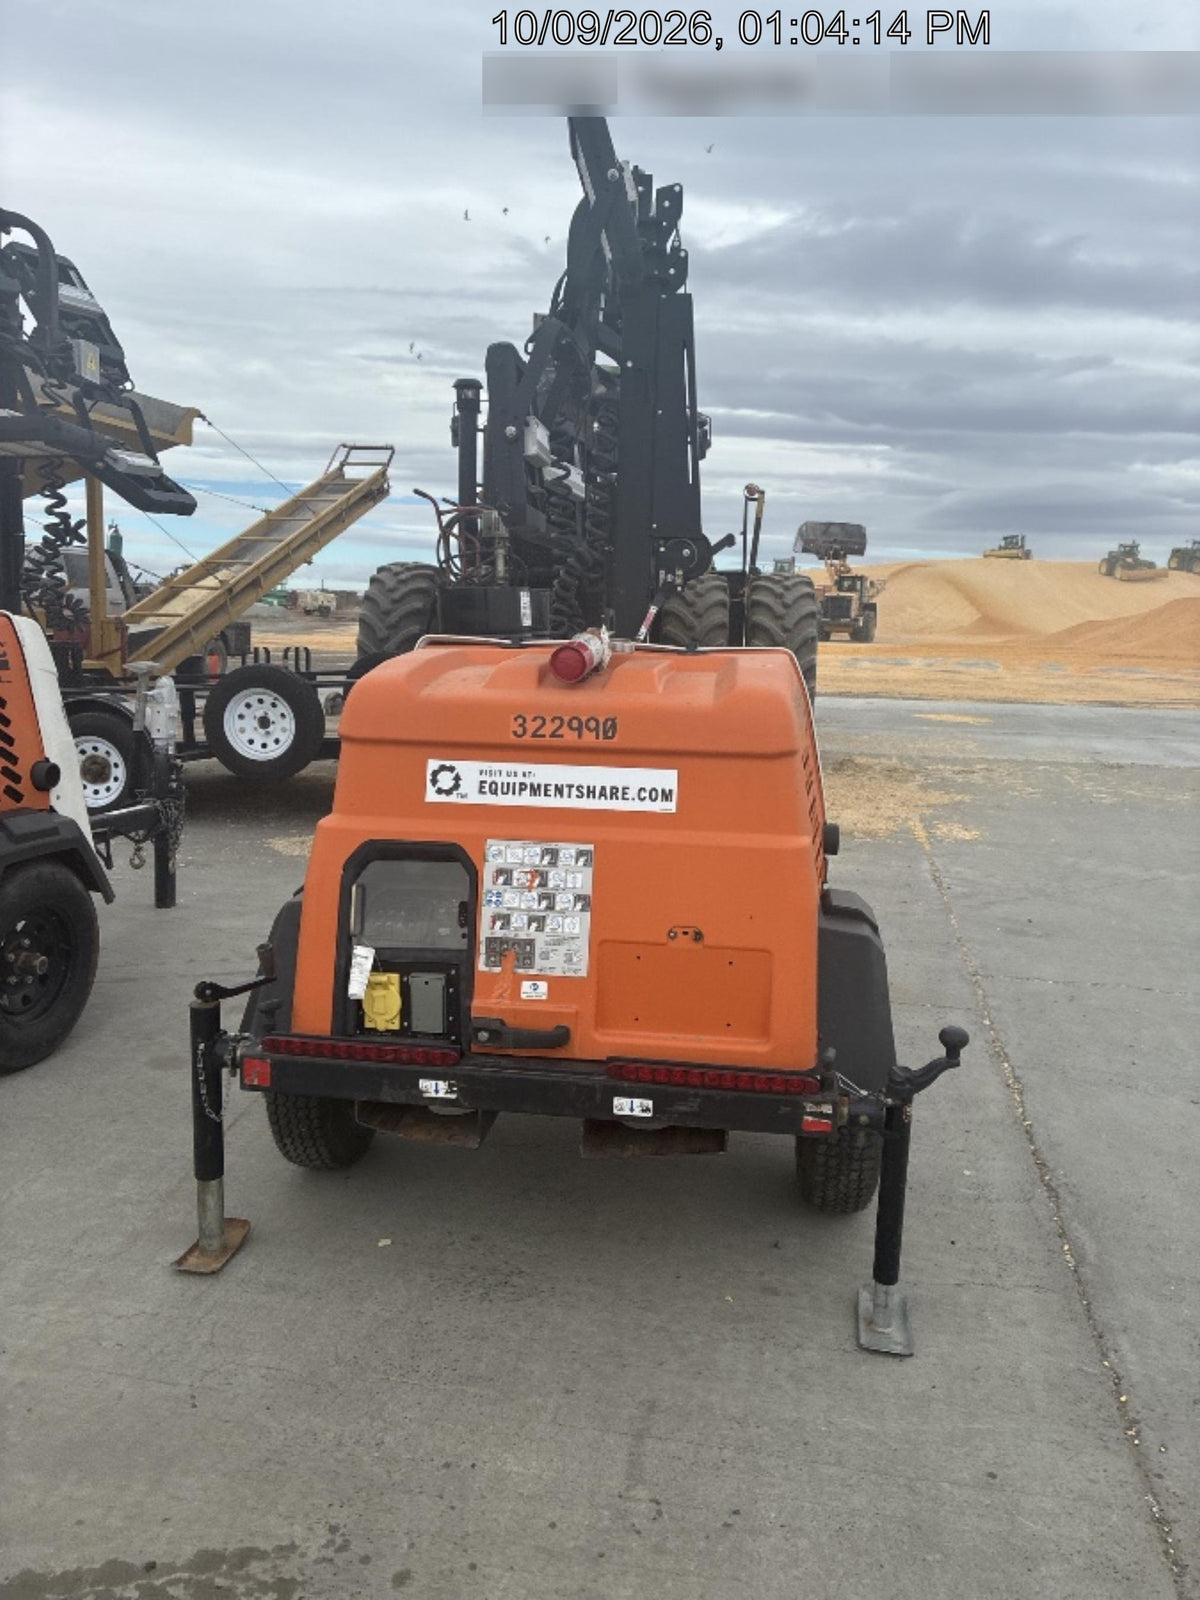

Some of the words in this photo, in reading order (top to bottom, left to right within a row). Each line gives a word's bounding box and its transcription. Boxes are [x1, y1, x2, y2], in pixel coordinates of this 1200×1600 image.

[511, 714, 618, 740] 322990
[479, 769, 502, 777] VISIT
[478, 780, 673, 802] EQUIPMENTSHARE.COM
